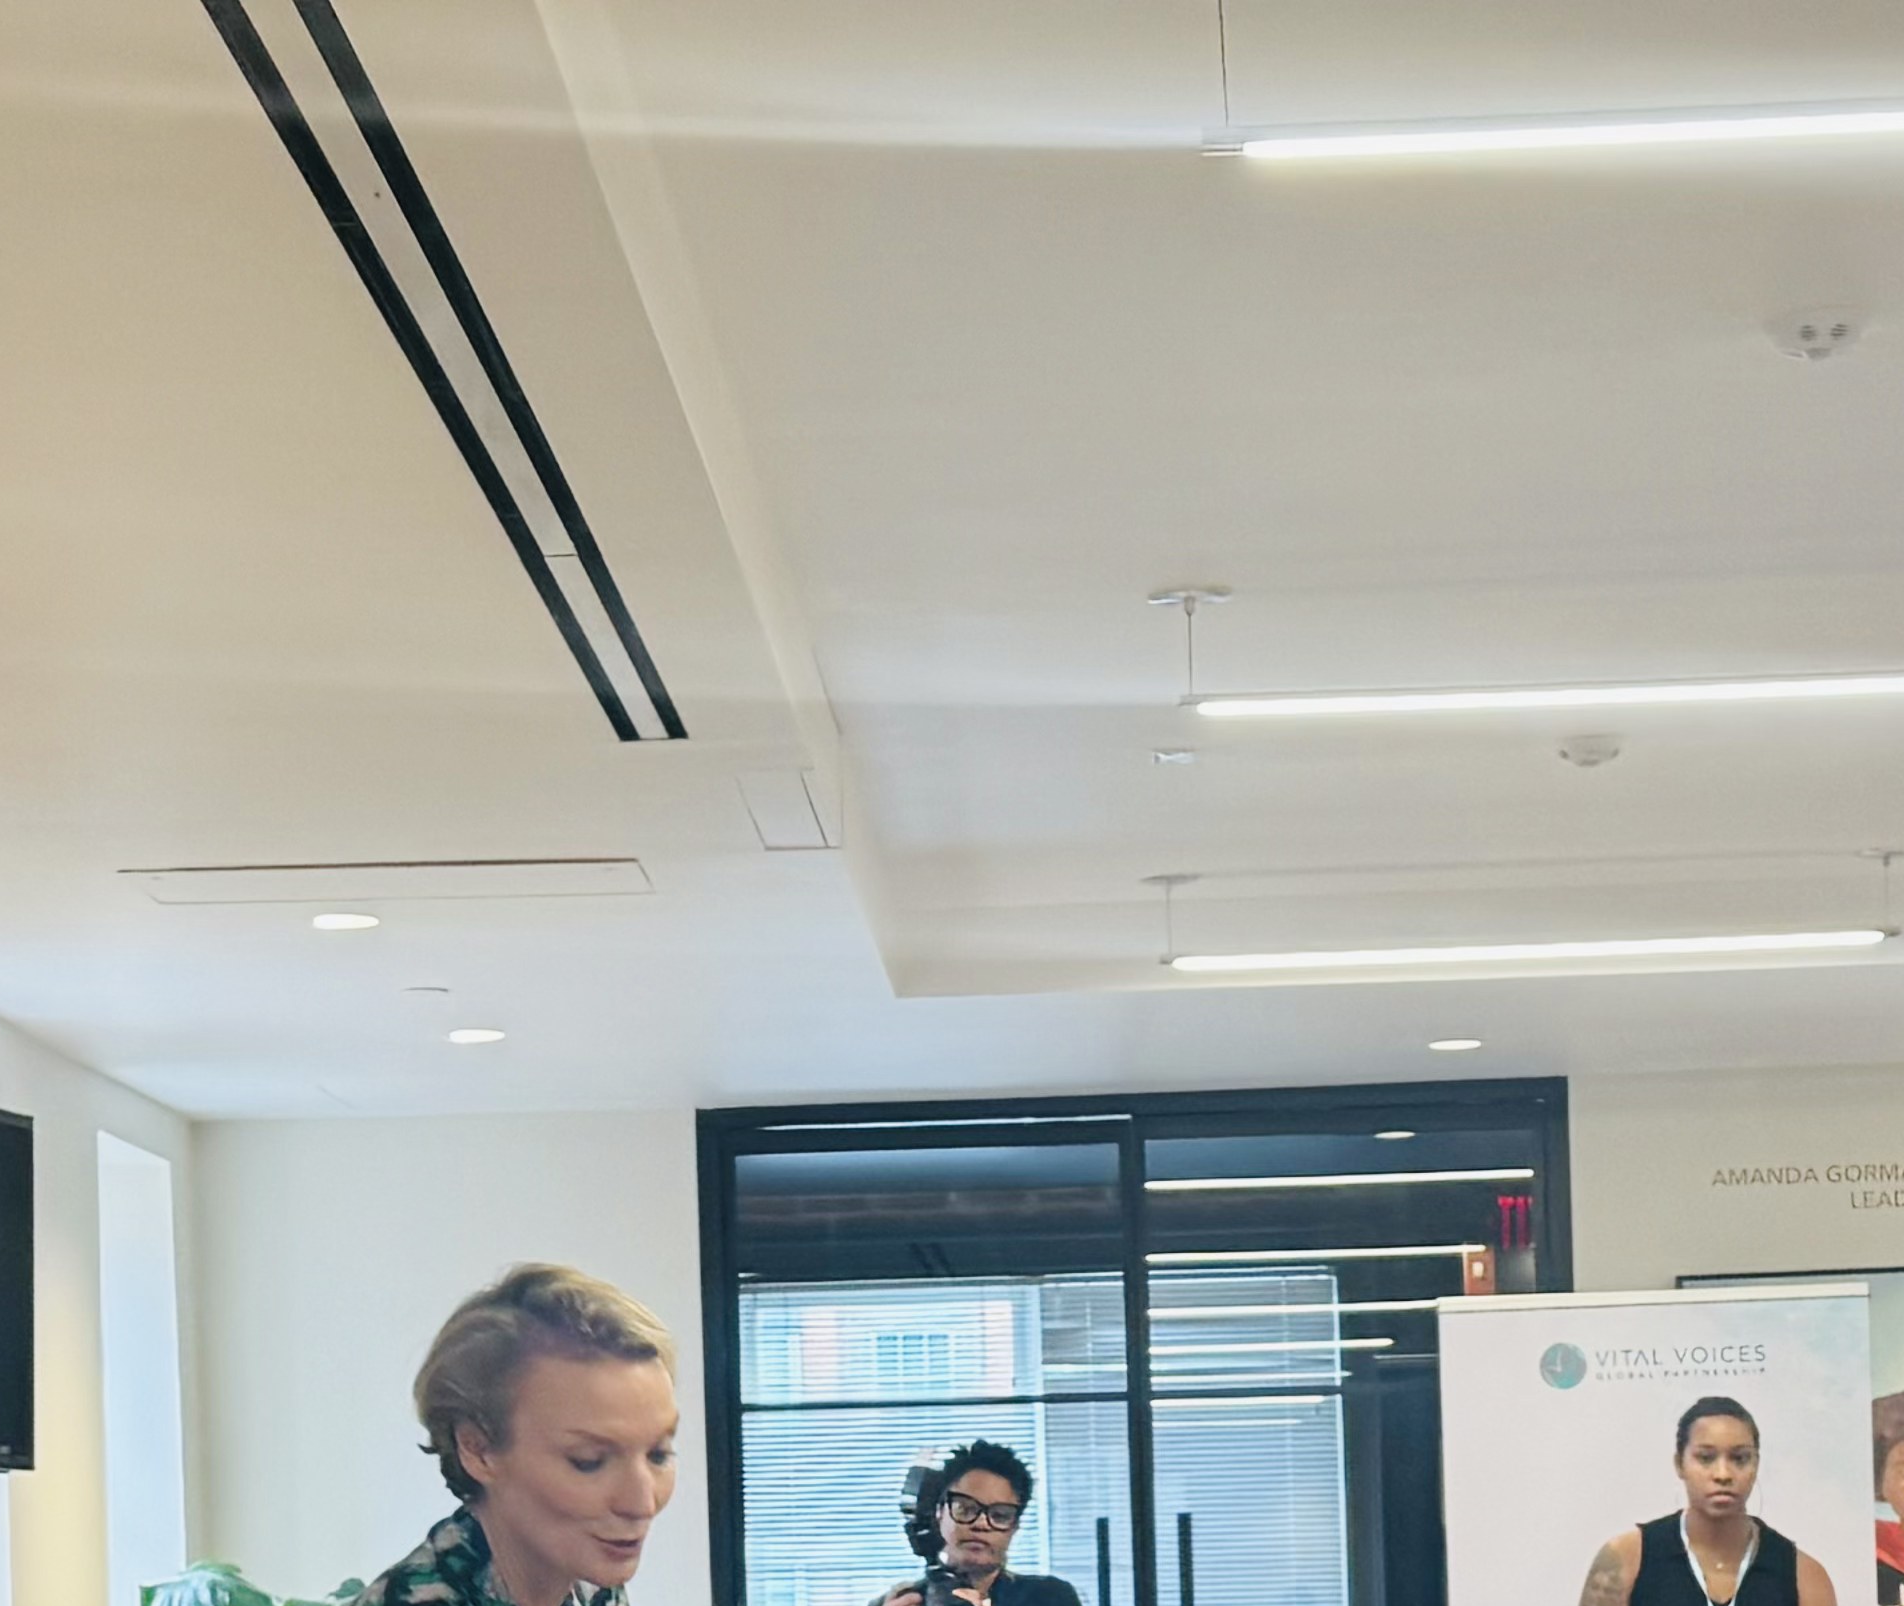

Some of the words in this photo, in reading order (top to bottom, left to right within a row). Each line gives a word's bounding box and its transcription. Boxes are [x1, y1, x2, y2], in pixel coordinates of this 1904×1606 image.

[1711, 1166, 1820, 1187] AMANDA
[1595, 1348, 1663, 1368] VITAL
[1673, 1344, 1767, 1365] VOICES
